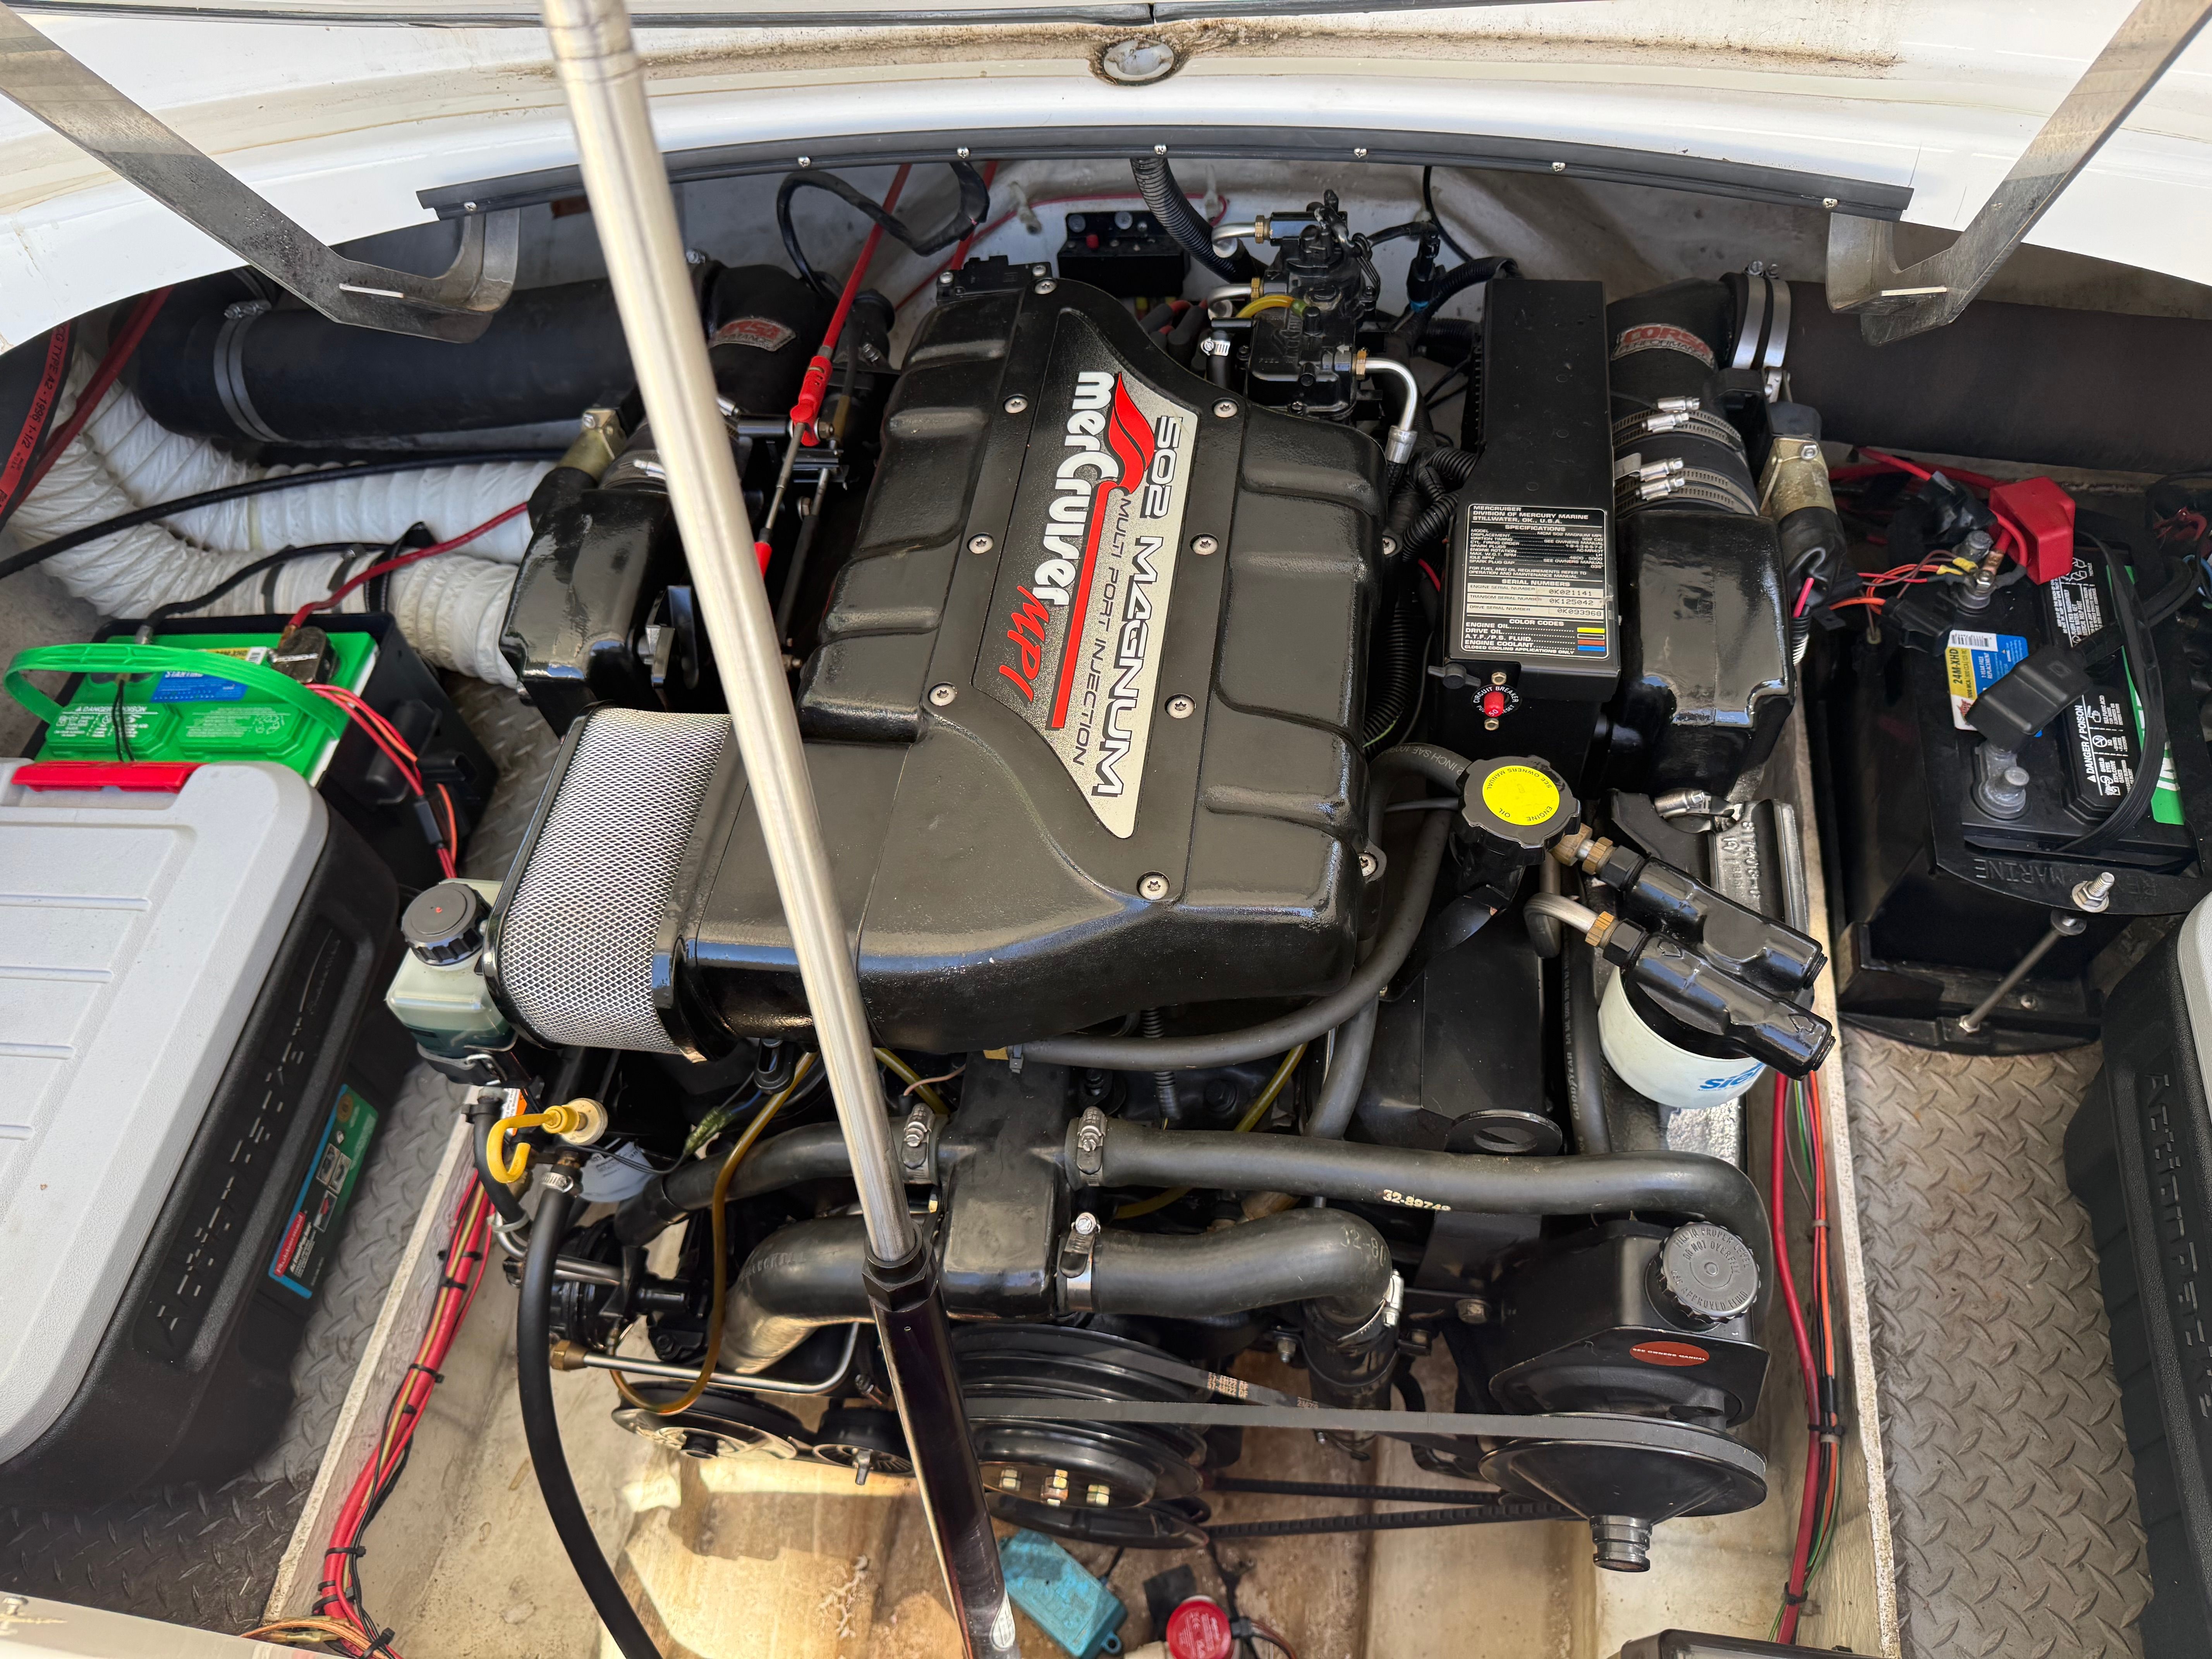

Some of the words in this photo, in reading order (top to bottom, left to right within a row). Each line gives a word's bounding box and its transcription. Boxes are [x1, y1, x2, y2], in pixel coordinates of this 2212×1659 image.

[46, 345, 64, 373] TYPE
[43, 374, 56, 390] A2
[1140, 416, 1183, 519] 502
[1032, 372, 1119, 606] merCruiser
[1112, 497, 1132, 559] MULTI
[1098, 567, 1118, 632] PORT
[2064, 589, 2072, 613] IMMEDIATELY
[998, 585, 1049, 702] MPI
[1091, 536, 1164, 798] MAGNUM
[1949, 647, 1963, 685] 24M-XHD
[1984, 652, 1992, 679] REPLACEMENT
[1073, 637, 1107, 766] INJECTION
[1473, 686, 1492, 703] CIRCUIT
[1496, 686, 1519, 702] BREAKER
[1502, 704, 1514, 714] ESET
[2075, 704, 2087, 734] POISON
[1412, 746, 1432, 757] SAE
[1431, 753, 1458, 771] INCH
[2081, 741, 2094, 774] DANGER
[1487, 770, 1506, 790] MANUAL
[1507, 768, 1540, 778] OWNERS
[1540, 777, 1552, 788] SEE
[2110, 760, 2119, 783] EXPLOSIVE
[1499, 808, 1511, 818] OIL
[1526, 806, 1553, 822] ENGINE
[1973, 858, 2066, 888] MARINE
[1566, 1051, 1580, 1120] GOODYEAR
[1691, 1240, 1707, 1252] NOT
[1701, 1227, 1733, 1245] PROPER
[1681, 1287, 1726, 1311] APPROVED
